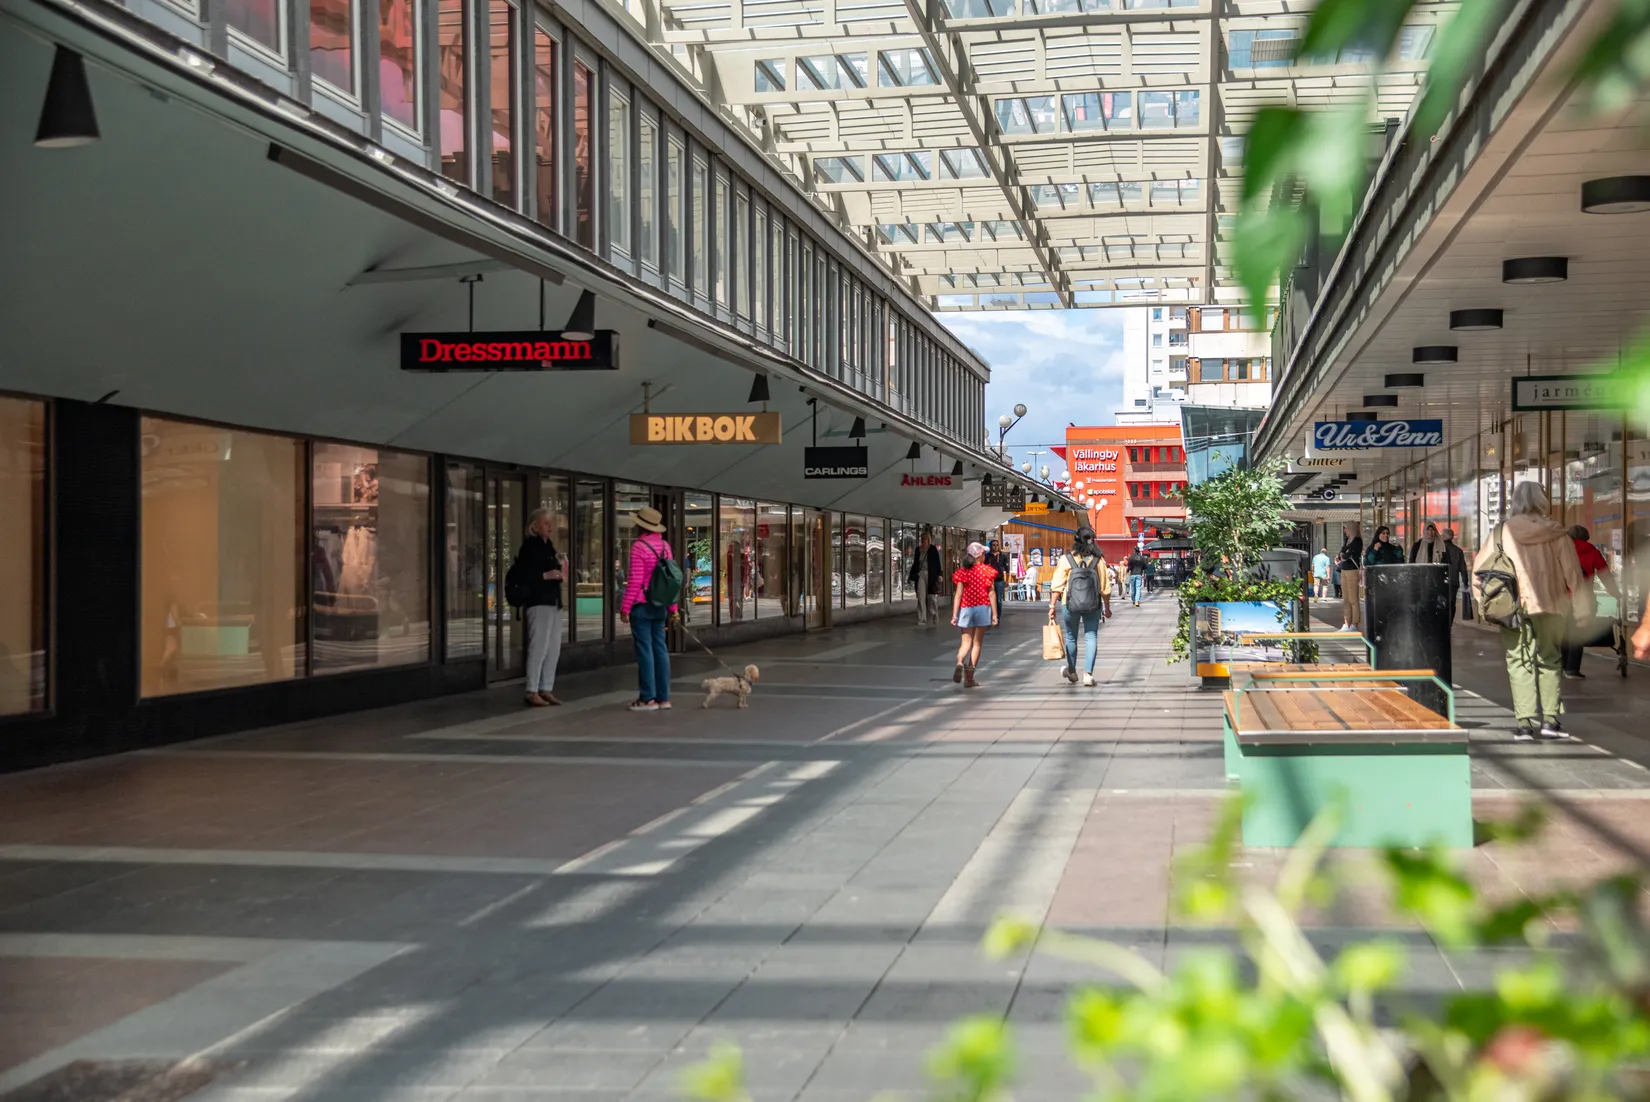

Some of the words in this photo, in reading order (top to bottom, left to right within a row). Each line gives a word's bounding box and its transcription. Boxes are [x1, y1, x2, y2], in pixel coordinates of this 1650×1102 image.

[419, 339, 592, 362] Dressmann
[1533, 383, 1616, 402] jarméu
[1072, 449, 1119, 460] Vällingby
[1074, 462, 1116, 471] läkarhus
[1297, 456, 1346, 467] Glitter
[805, 467, 868, 476] CARLINGS
[900, 473, 952, 487] ÅHLÉNS
